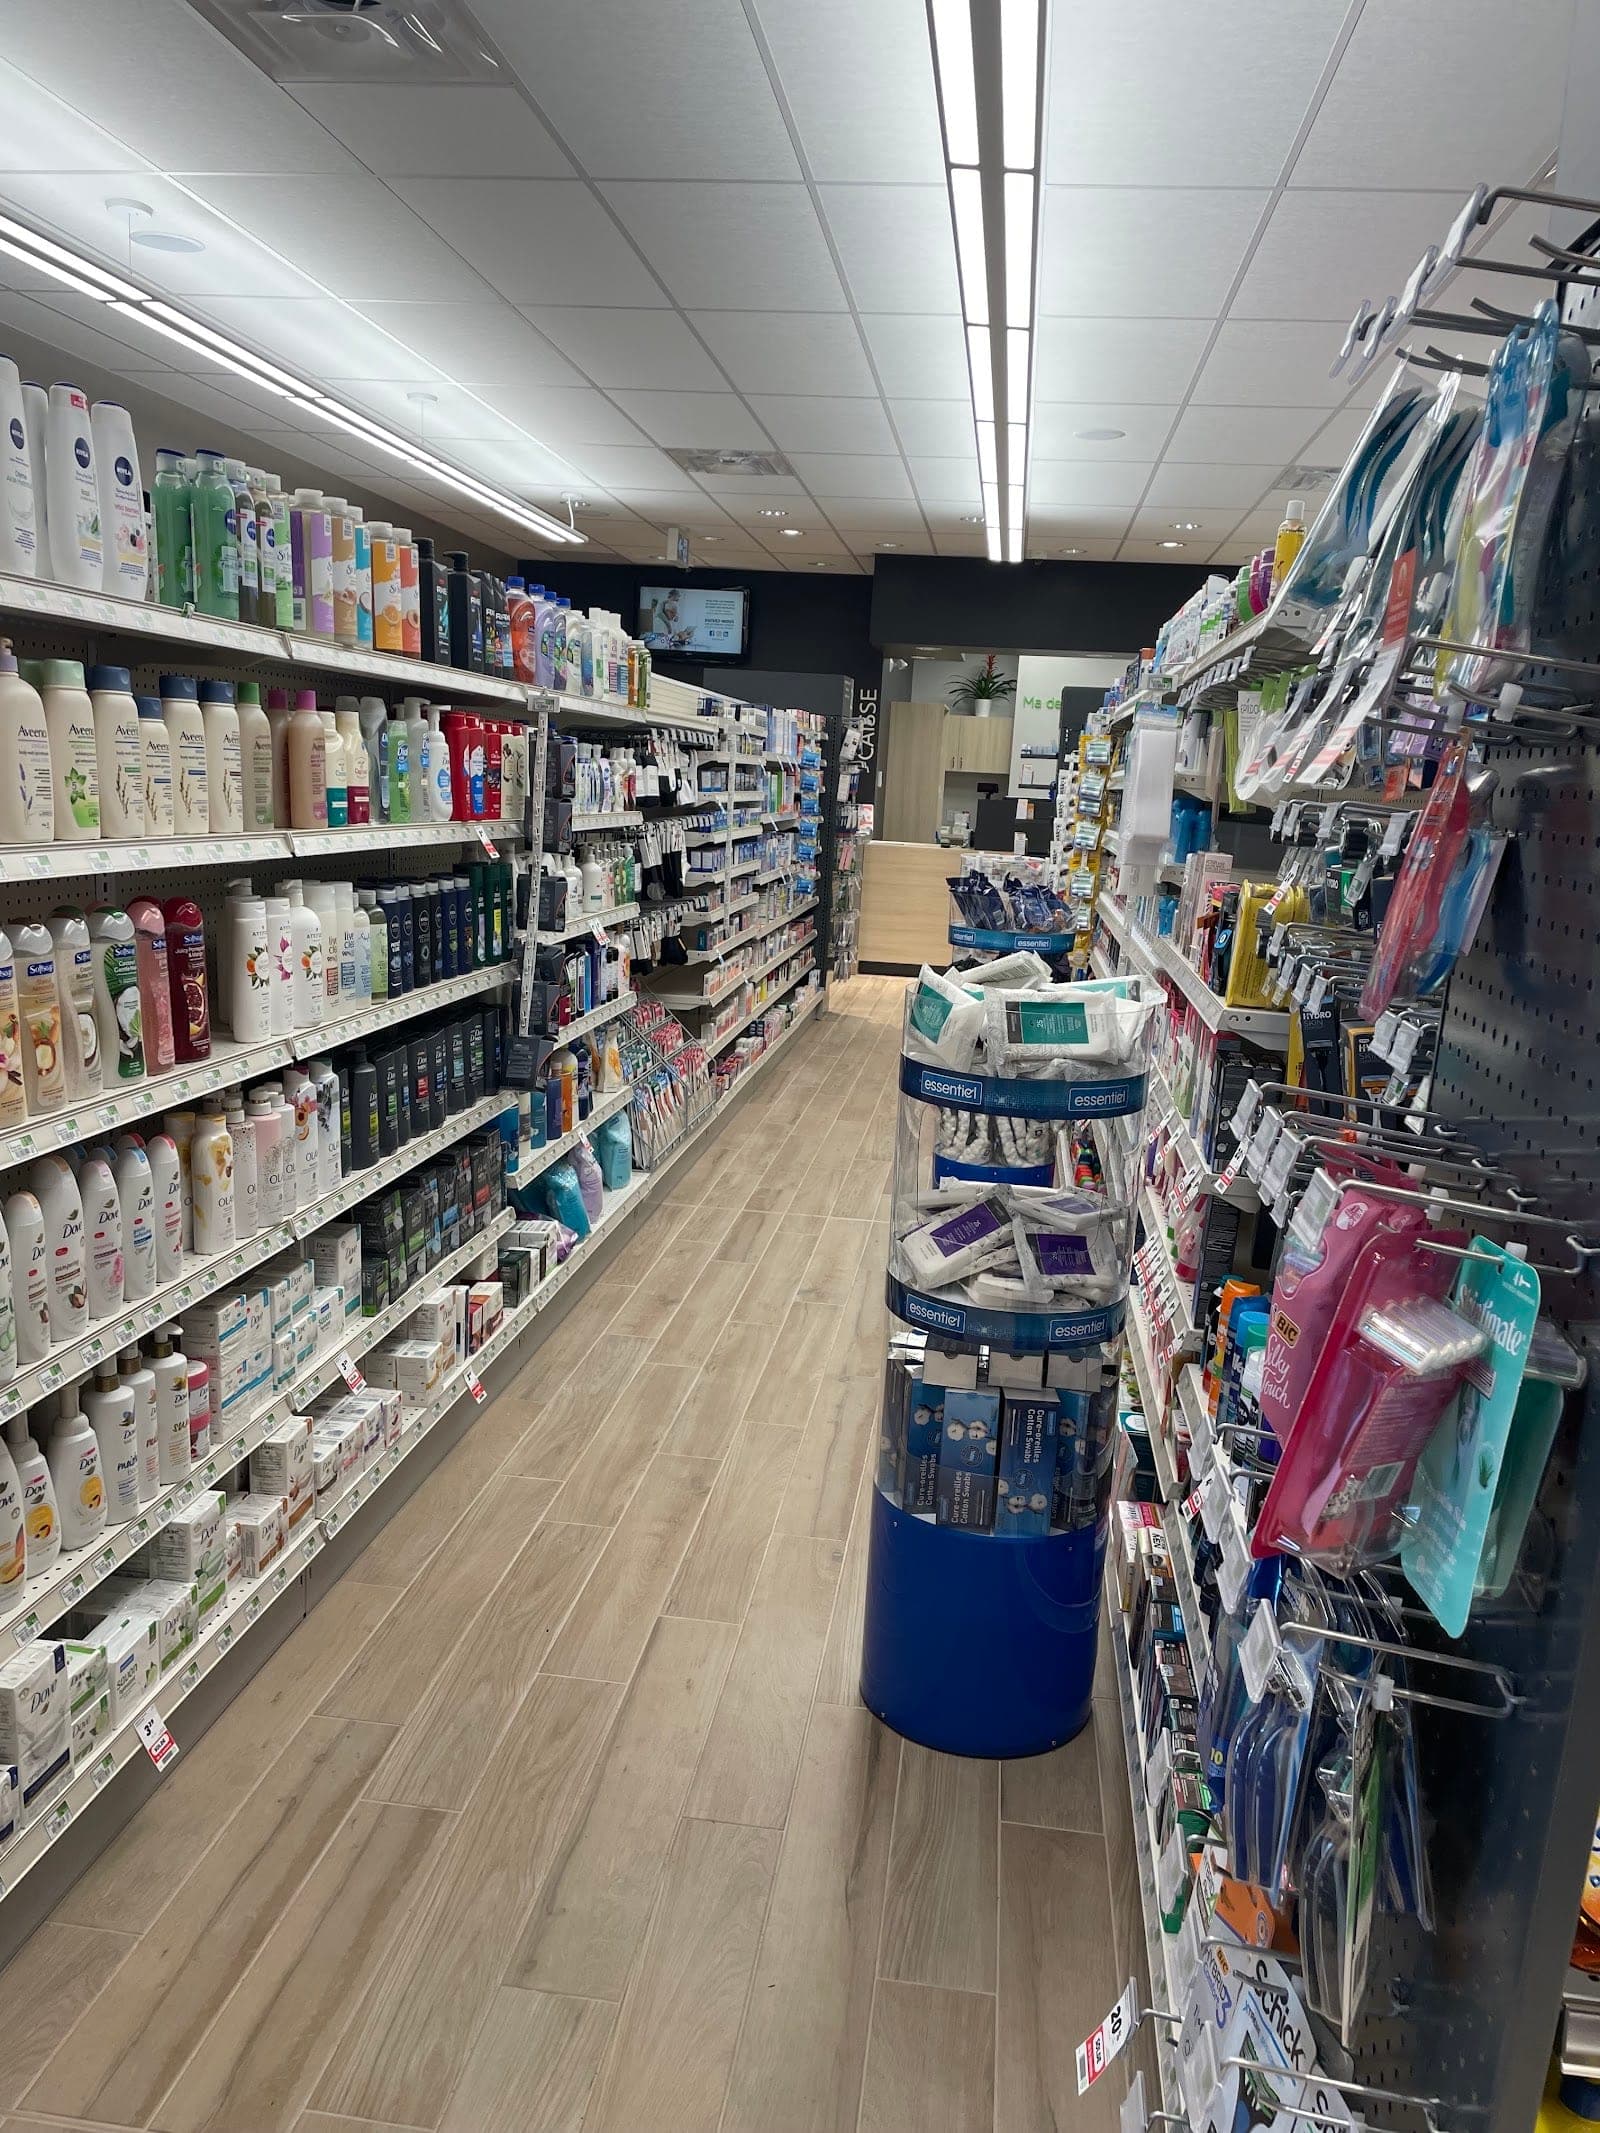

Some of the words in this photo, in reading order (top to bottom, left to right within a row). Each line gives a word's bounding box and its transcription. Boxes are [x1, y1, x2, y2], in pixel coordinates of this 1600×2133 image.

[1023, 696, 1042, 709] Ma
[69, 724, 95, 736] Aveen
[115, 725, 140, 737] Aveen
[180, 731, 204, 742] Aveen
[858, 688, 878, 760] CAISSE
[146, 740, 170, 752] Aveen
[1303, 1010, 1332, 1020] HYDRO
[924, 1077, 977, 1100] essentiel
[1074, 1088, 1126, 1108] essentiel
[908, 1303, 962, 1327] essentiel
[1054, 1319, 1107, 1338] essentiel
[1276, 1315, 1299, 1342] BIC
[1264, 1333, 1291, 1383] Silky
[1261, 1366, 1291, 1409] Touch
[1025, 1408, 1036, 1437] Cotton
[1032, 1409, 1045, 1464] Cure-oreilles
[1023, 1438, 1033, 1464] Swabs
[929, 1453, 937, 1479] Swabs
[24, 1481, 48, 1499] Dove
[925, 1480, 935, 1507] Cotton
[951, 1471, 963, 1524] Cure-oreilles
[963, 1472, 972, 1497] Swabs
[960, 1498, 970, 1525] Cotton
[30, 1678, 58, 1714] Dove
[1210, 1748, 1223, 1763] 10
[1216, 1949, 1230, 1975] BIC
[1254, 1958, 1307, 2072] Schick
